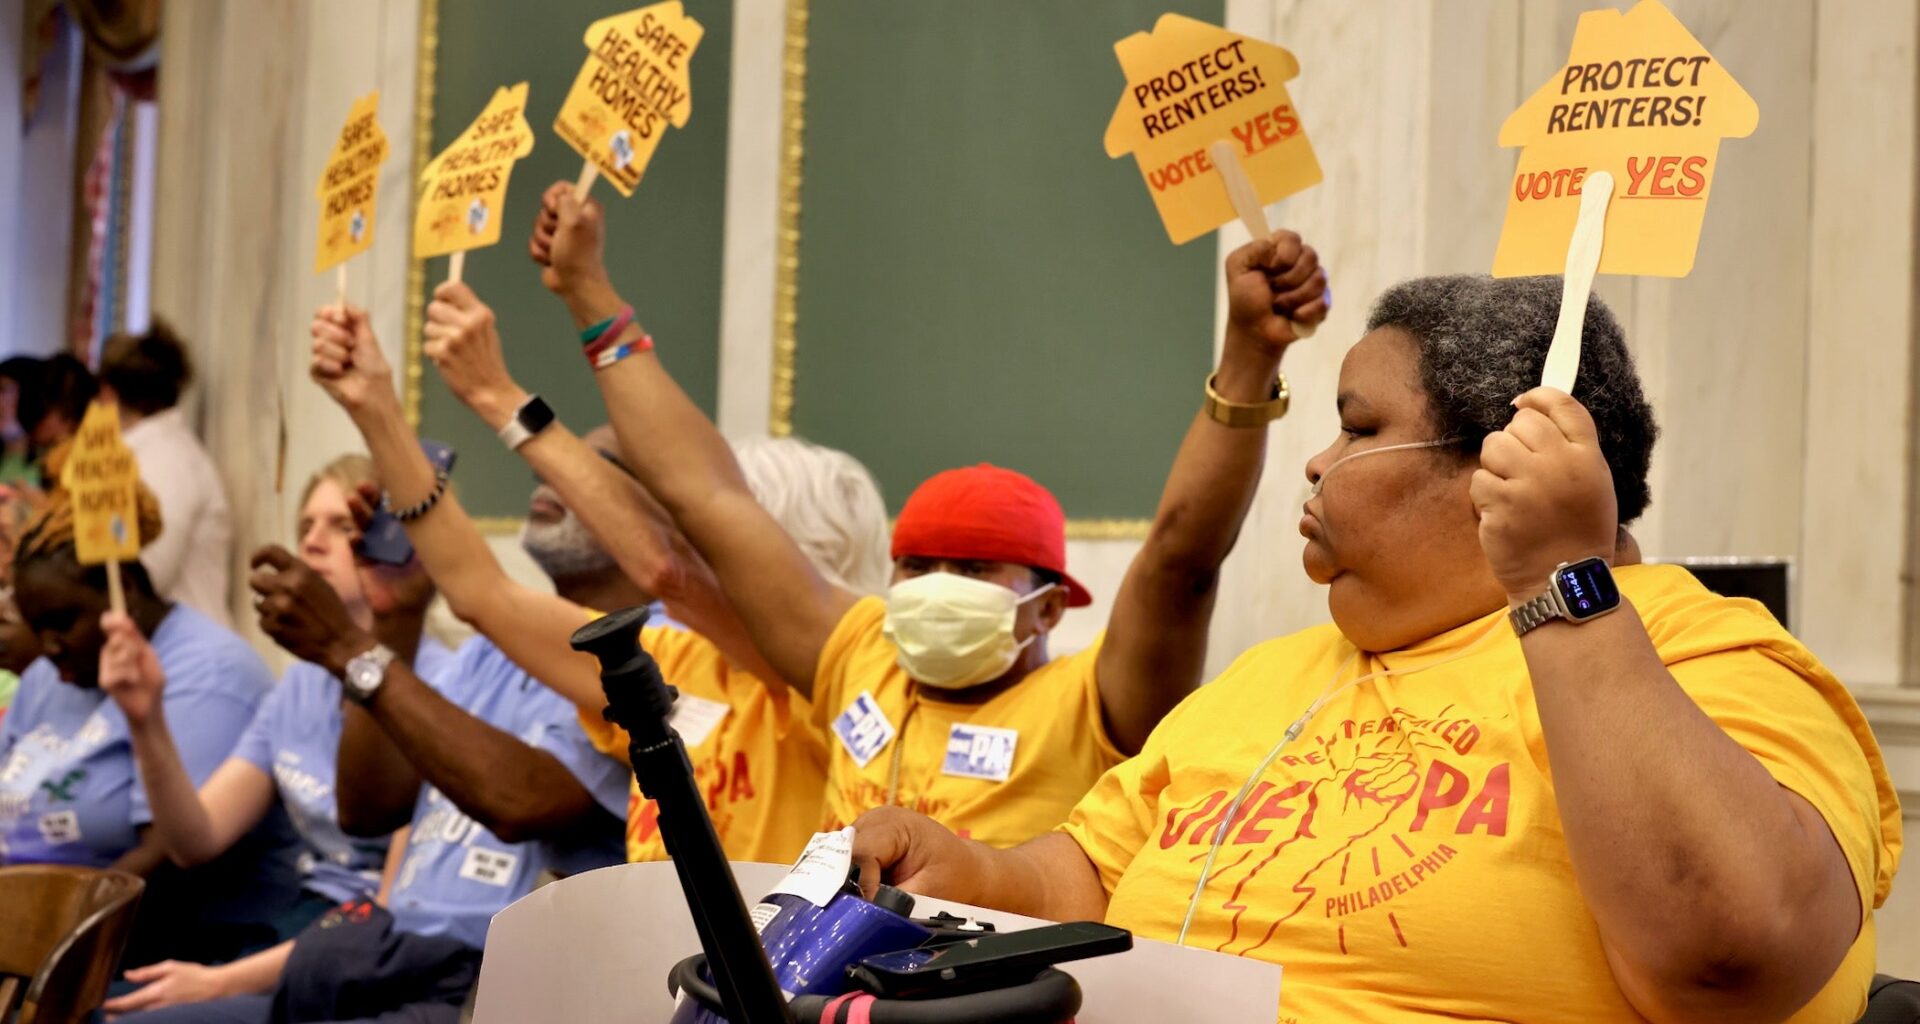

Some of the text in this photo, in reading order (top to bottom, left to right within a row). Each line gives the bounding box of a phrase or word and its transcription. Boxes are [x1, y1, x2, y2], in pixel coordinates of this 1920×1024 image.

[635, 13, 687, 70] SAFE
[598, 28, 686, 112] HEALTHY
[1134, 40, 1246, 108] PROTECT
[1561, 56, 1710, 95] PROTECT
[471, 106, 519, 141] SAFE
[589, 66, 657, 139] HOMES
[1142, 67, 1266, 138] RENTERS!
[1547, 96, 1706, 134] RENTERS!
[341, 111, 375, 151] SAFE
[437, 134, 525, 175] HEALTHY
[1149, 105, 1299, 192] VOTE YES
[324, 138, 385, 190] HEALTHY
[432, 165, 503, 201] HOMES
[1515, 156, 1707, 201] VOTE YES
[325, 174, 374, 220] HOMES
[1160, 759, 1512, 850] ONE PA
[1326, 843, 1458, 918] PHILADELPHIA
